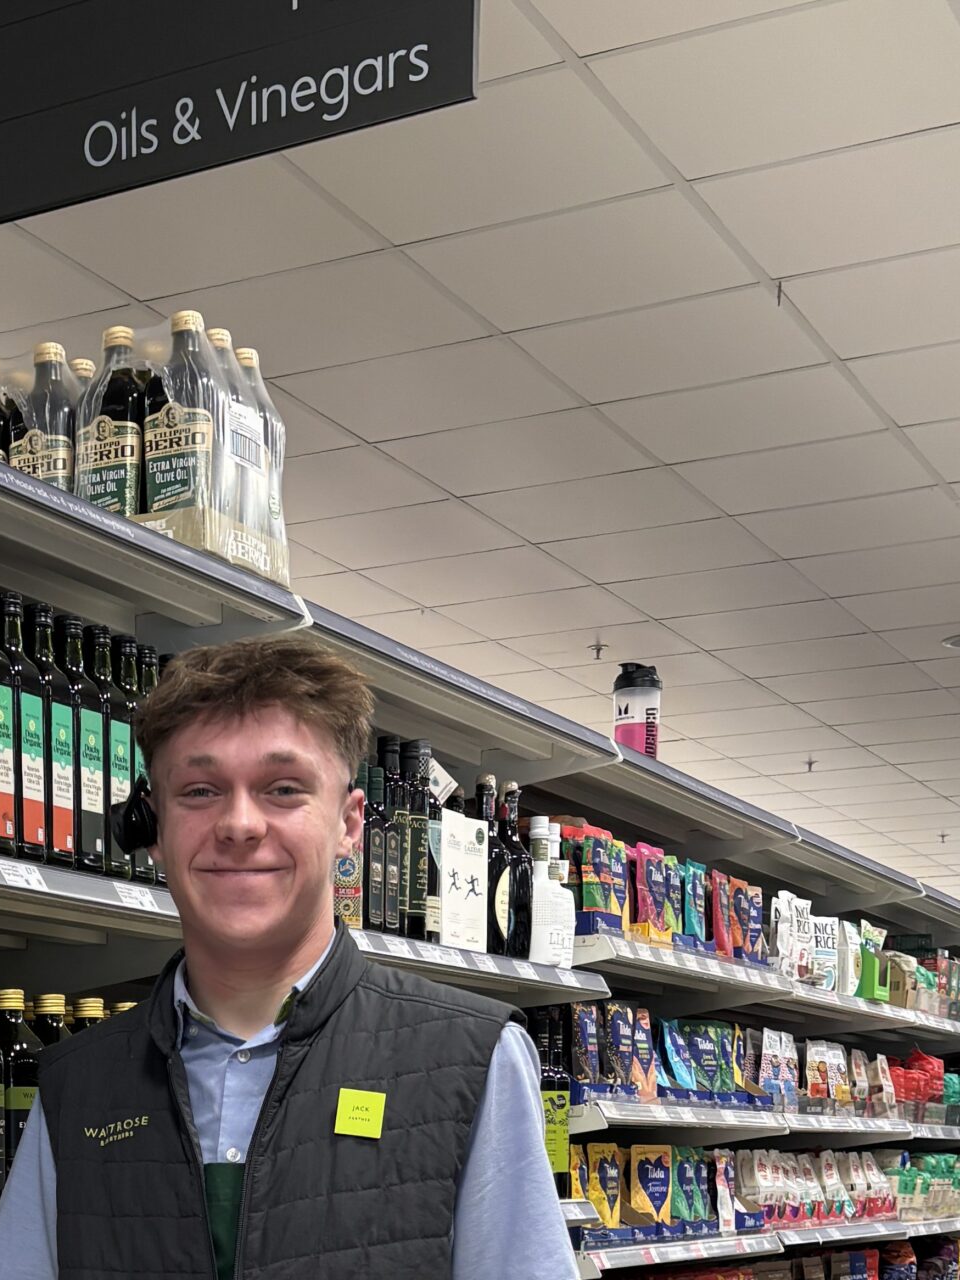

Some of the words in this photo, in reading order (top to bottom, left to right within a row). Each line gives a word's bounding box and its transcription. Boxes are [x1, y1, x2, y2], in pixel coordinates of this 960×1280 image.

[84, 106, 158, 167] Oils
[173, 97, 201, 144] &
[216, 43, 429, 131] Vinegars
[153, 427, 191, 439] FILIPPO
[144, 431, 206, 453] BERIO
[149, 459, 170, 473] EXTRA
[172, 456, 196, 469] VIRGIN
[155, 470, 175, 484] OLIVE
[176, 468, 188, 479] OIL
[814, 922, 836, 936] NICE
[814, 935, 837, 950] RICE
[694, 1037, 715, 1050] Tilda
[352, 1104, 370, 1112] JACK
[84, 1115, 149, 1139] WAITROSE
[644, 1165, 665, 1181] Tilda
